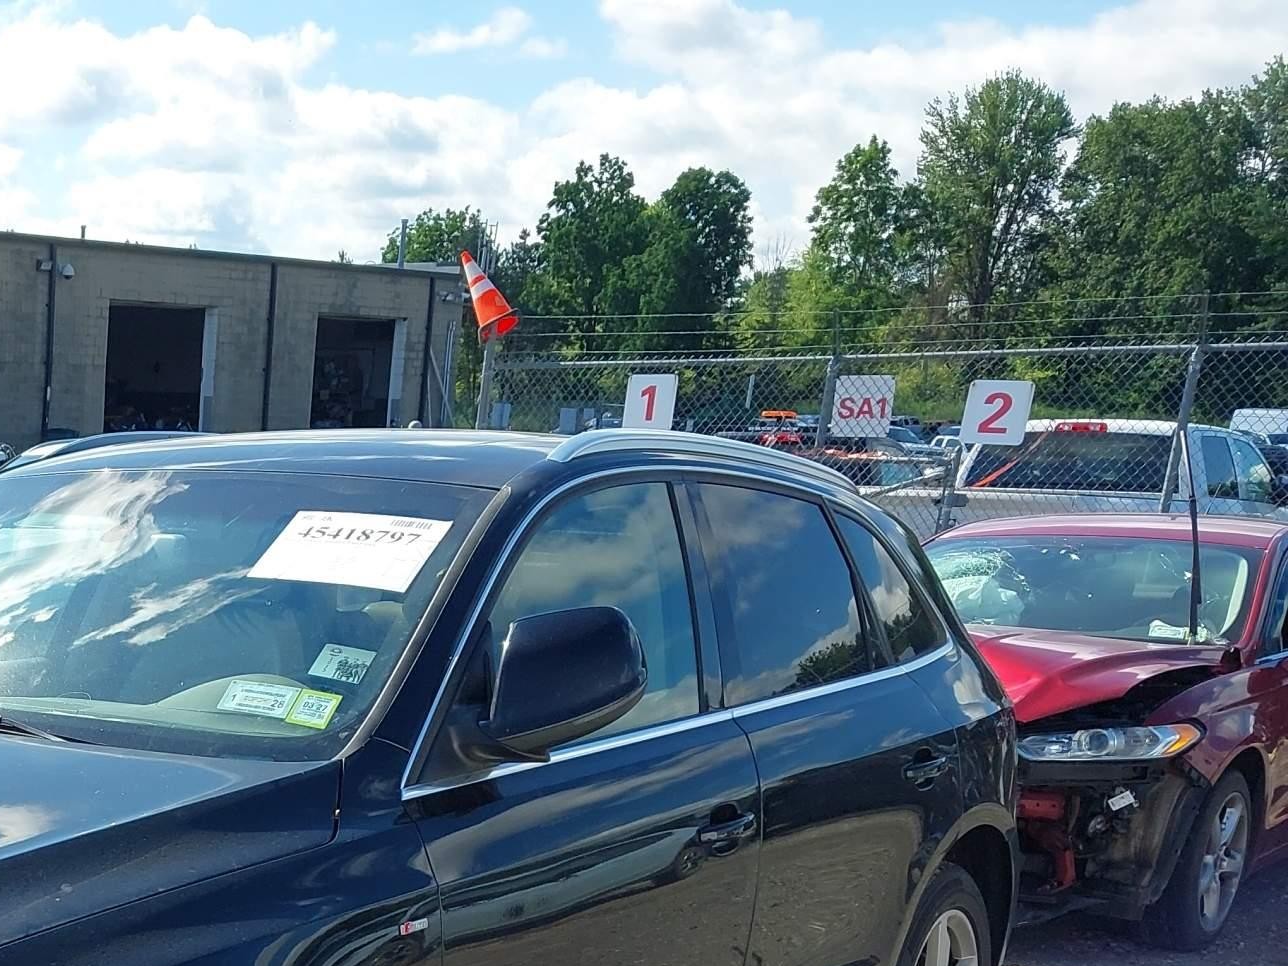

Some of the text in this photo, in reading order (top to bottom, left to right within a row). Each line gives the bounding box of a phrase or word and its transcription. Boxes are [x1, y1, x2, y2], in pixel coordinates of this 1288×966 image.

[640, 384, 657, 422] 1
[837, 396, 889, 420] SA1
[976, 391, 1014, 434] 2
[298, 526, 422, 545] 45418797
